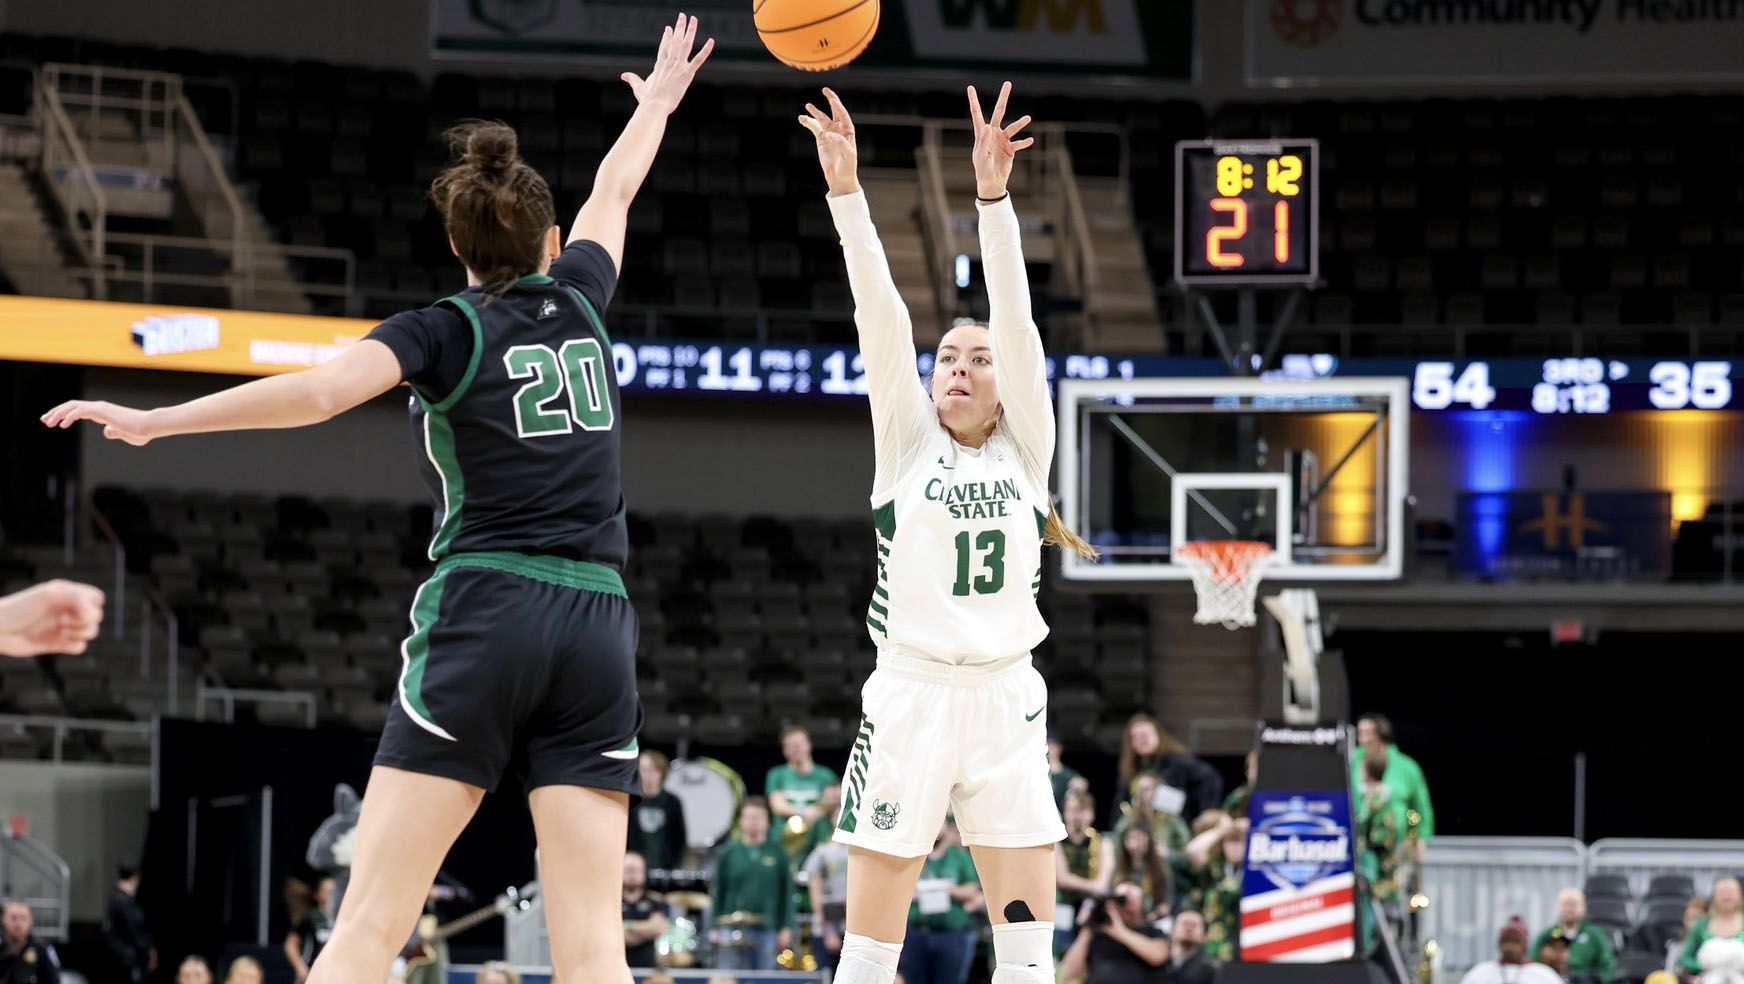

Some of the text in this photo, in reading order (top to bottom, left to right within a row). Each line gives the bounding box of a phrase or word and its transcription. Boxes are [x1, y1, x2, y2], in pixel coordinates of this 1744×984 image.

[1355, 0, 1600, 33] Community
[1216, 154, 1303, 197] 8:12
[1206, 197, 1290, 267] 21
[503, 338, 614, 438] 20
[697, 346, 763, 391] 11
[1413, 362, 1495, 409] 54
[1542, 358, 1605, 384] 3RD
[1648, 362, 1731, 409] 35
[1531, 382, 1610, 413] 8:12
[924, 477, 1022, 505] CEVELAN
[948, 500, 1008, 519] STATE
[952, 529, 1006, 597] 13
[1248, 833, 1348, 863] Barbasol
